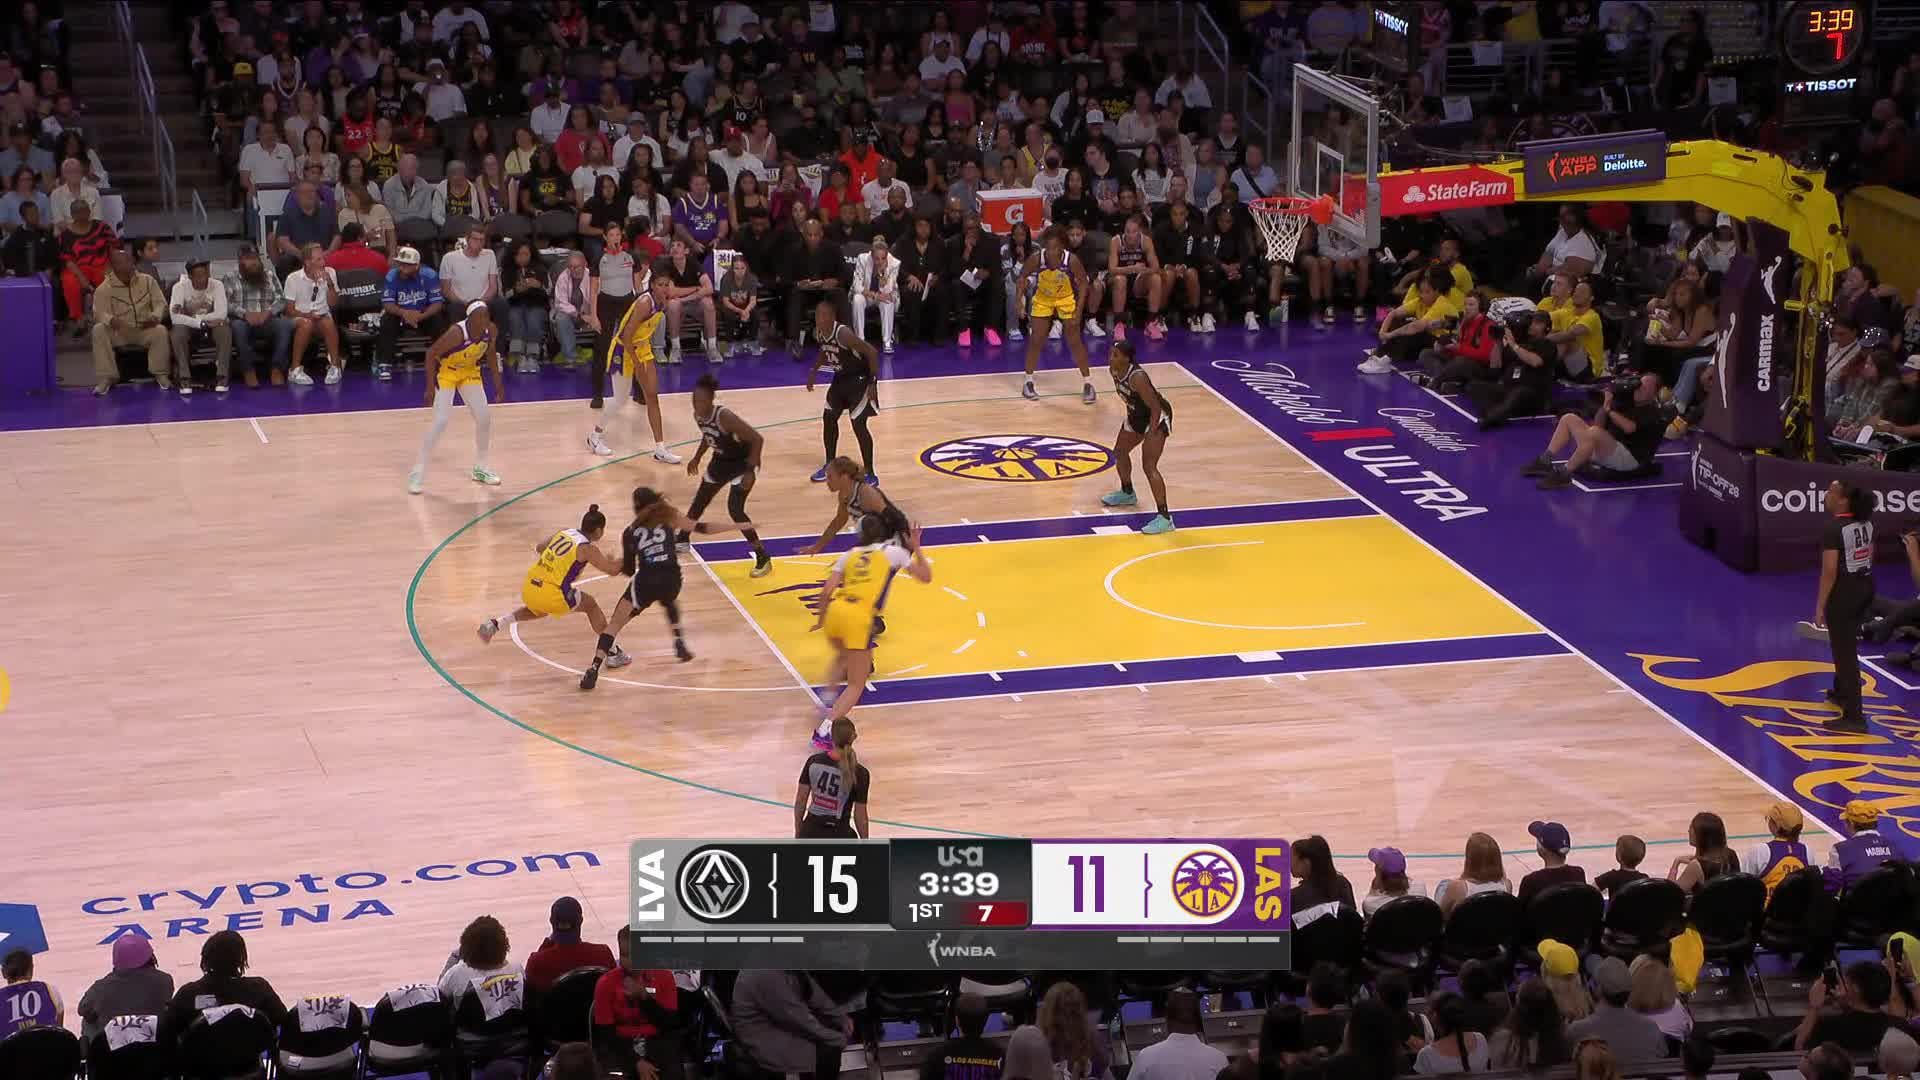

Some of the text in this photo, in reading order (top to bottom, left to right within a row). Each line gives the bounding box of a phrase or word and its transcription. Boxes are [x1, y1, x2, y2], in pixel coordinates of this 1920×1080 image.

[1809, 9, 1854, 33] 3:39
[1826, 32, 1843, 60] 7
[1806, 78, 1857, 92] TISSOT
[1560, 154, 1598, 168] WNBA
[1560, 163, 1597, 177] APP
[1005, 203, 1024, 225] G
[1211, 360, 1359, 424] Michelob
[1344, 444, 1489, 522] ULTRA
[1761, 481, 1920, 513] coiase
[549, 534, 574, 557] 10
[816, 770, 842, 798] 45
[81, 851, 601, 915] crypto.com
[96, 899, 394, 945] ARENA
[6, 990, 42, 1024] 10
